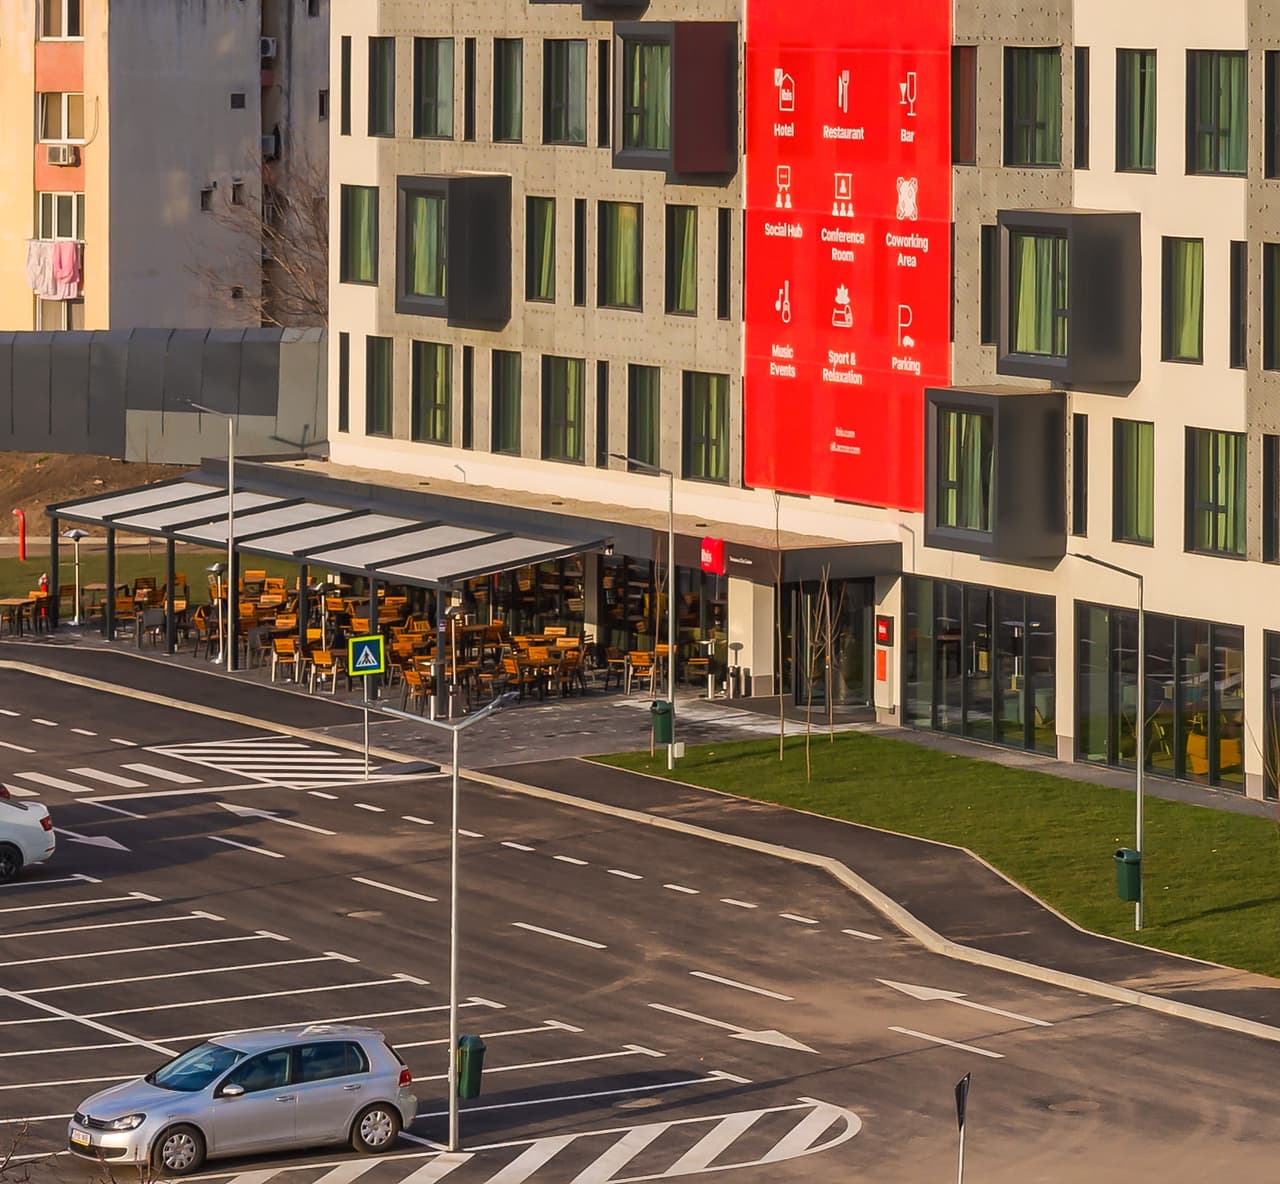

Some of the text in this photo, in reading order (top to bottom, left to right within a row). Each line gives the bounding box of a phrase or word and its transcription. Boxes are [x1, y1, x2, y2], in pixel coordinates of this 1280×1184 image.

[773, 122, 795, 137] Hotel
[823, 125, 865, 140] Restaurant
[900, 128, 915, 143] Bar
[764, 222, 803, 238] Social Hub
[821, 227, 865, 244] Conference
[885, 232, 929, 253] Coworking
[831, 247, 855, 262] Room
[897, 253, 917, 267] Area
[771, 344, 794, 359] Music
[828, 350, 857, 368] Sport &
[770, 362, 796, 378] Events
[891, 356, 921, 376] Parking
[822, 367, 863, 385] Relaxation
